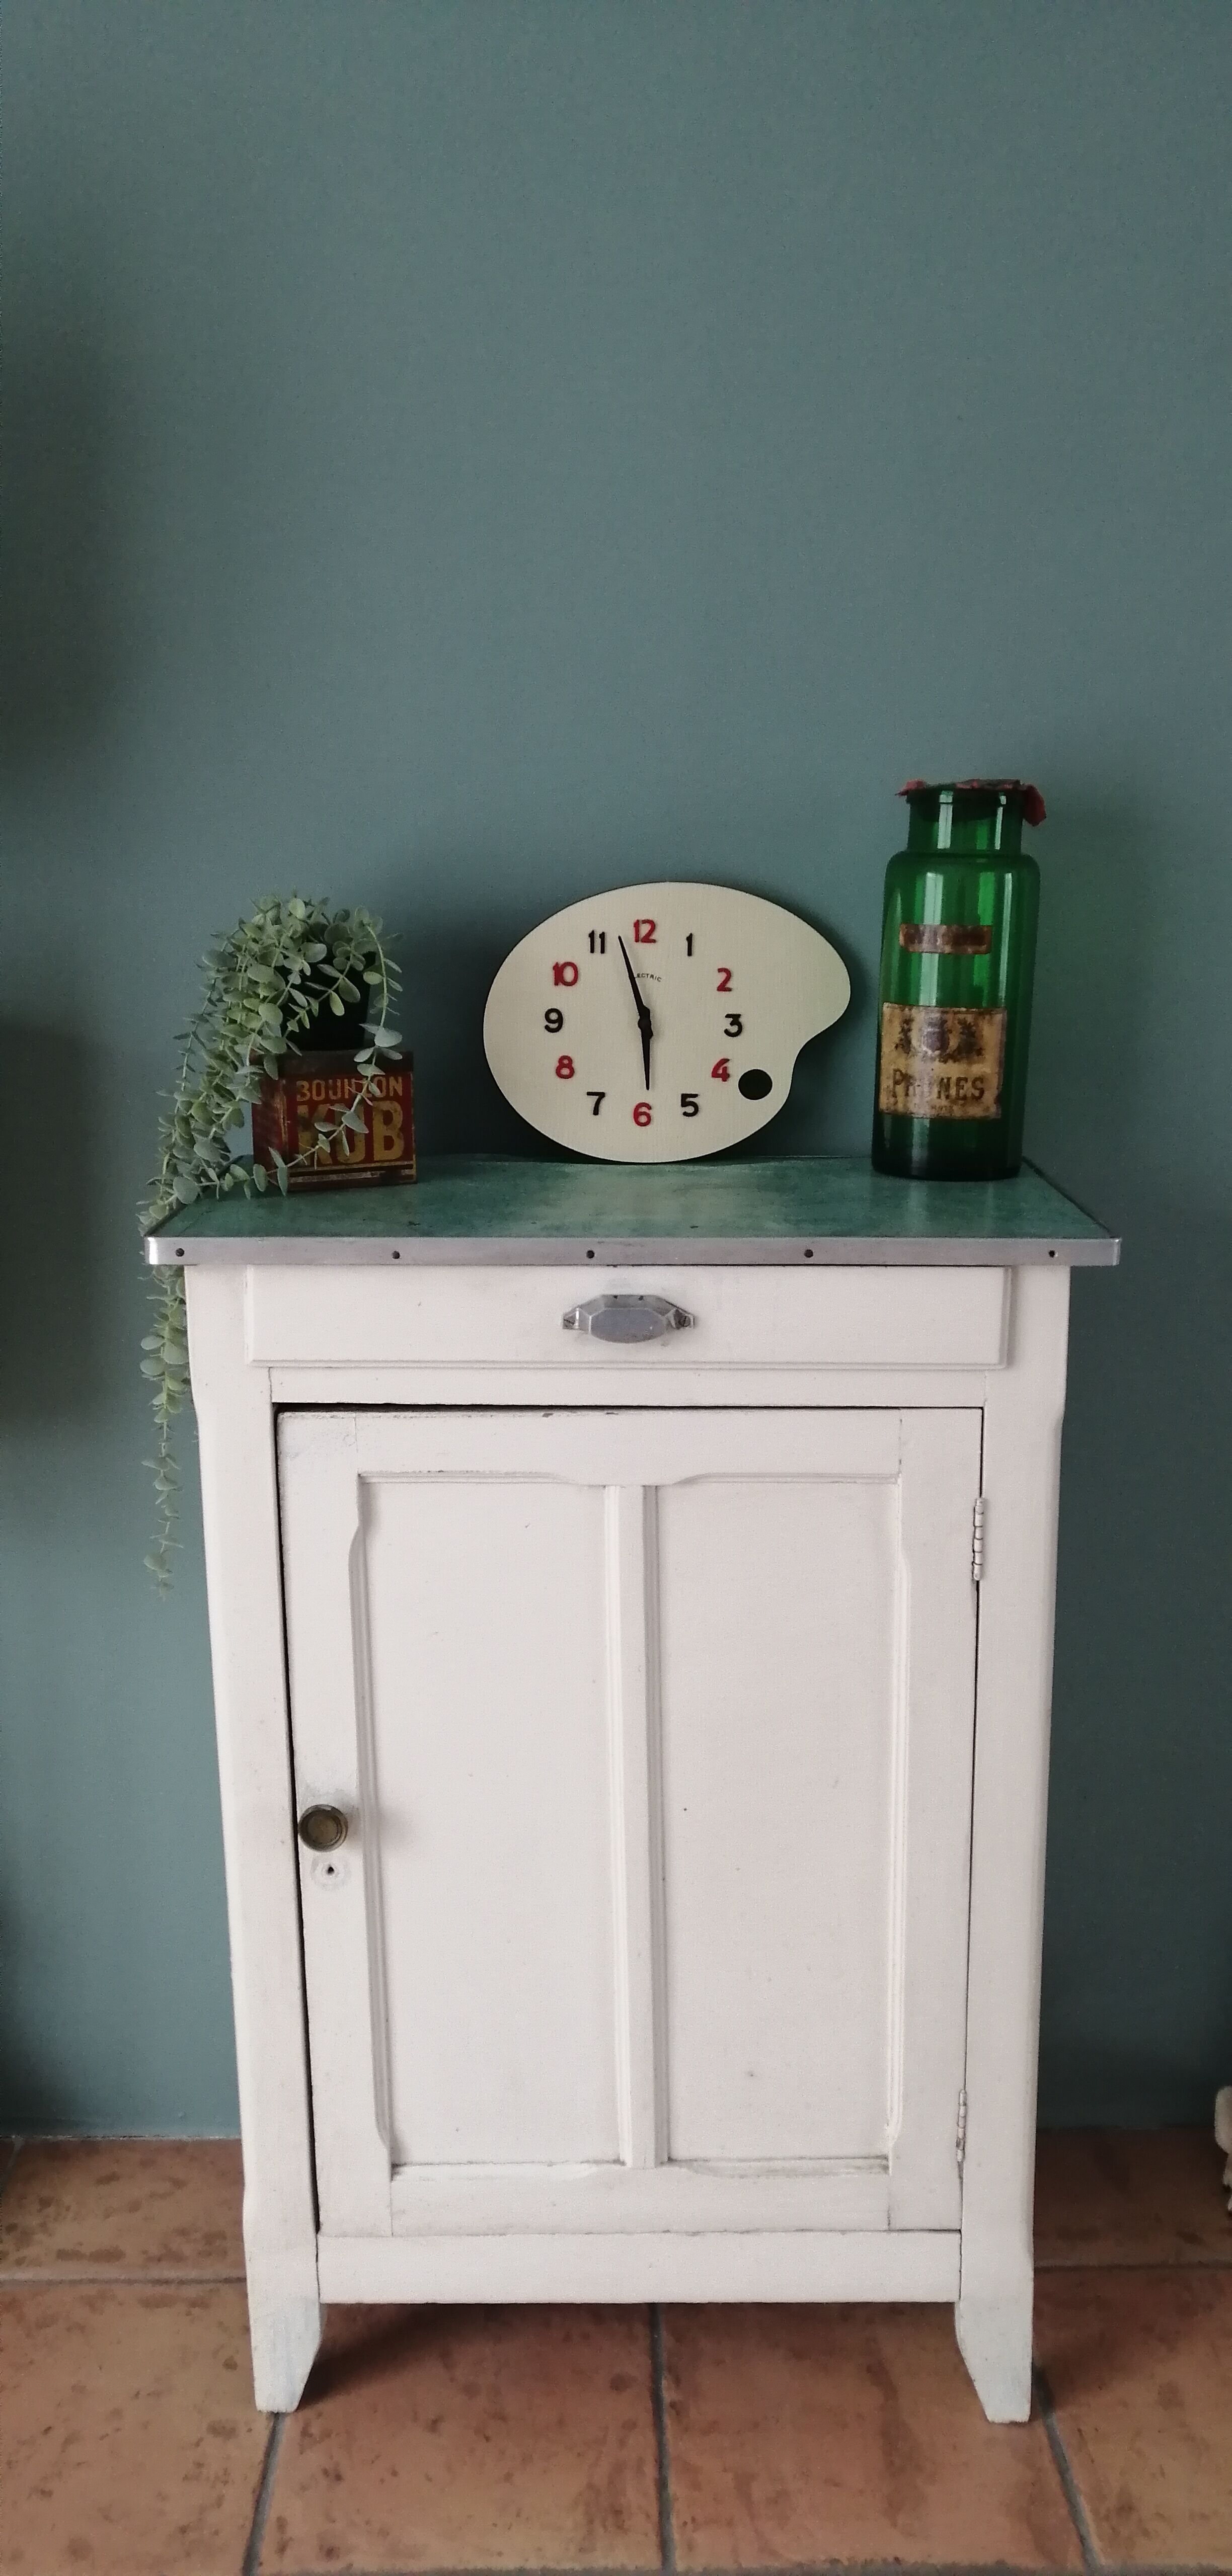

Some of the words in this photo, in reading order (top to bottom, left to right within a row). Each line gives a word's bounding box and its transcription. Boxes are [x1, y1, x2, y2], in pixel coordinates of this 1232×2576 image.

[588, 930, 605, 954] 11
[634, 919, 656, 943] 12
[686, 933, 692, 956] 1
[553, 962, 578, 987] 10
[717, 968, 732, 992] 2
[545, 1008, 563, 1033] 9
[724, 1014, 743, 1037] 3
[556, 1056, 575, 1079] 8
[712, 1058, 730, 1082] 4
[587, 1092, 605, 1115] 7
[633, 1102, 652, 1126] 6
[681, 1093, 699, 1117] 5
[297, 1100, 405, 1165] KUB
